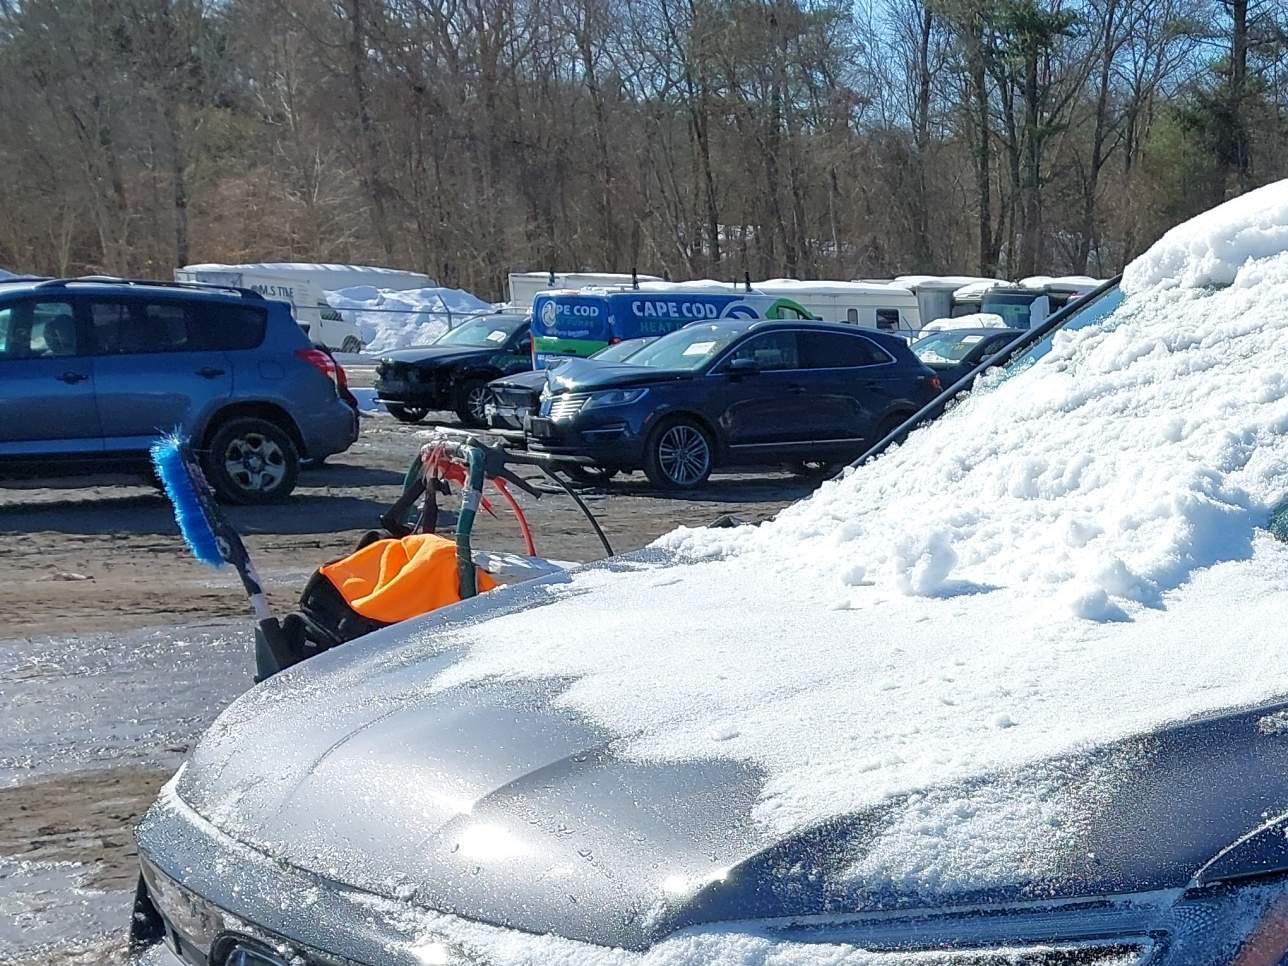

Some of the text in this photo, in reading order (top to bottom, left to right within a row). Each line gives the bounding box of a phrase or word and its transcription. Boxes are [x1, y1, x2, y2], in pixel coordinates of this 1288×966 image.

[573, 305, 599, 317] COD
[632, 301, 718, 318] CAPE COD
[640, 321, 673, 333] HEAT
